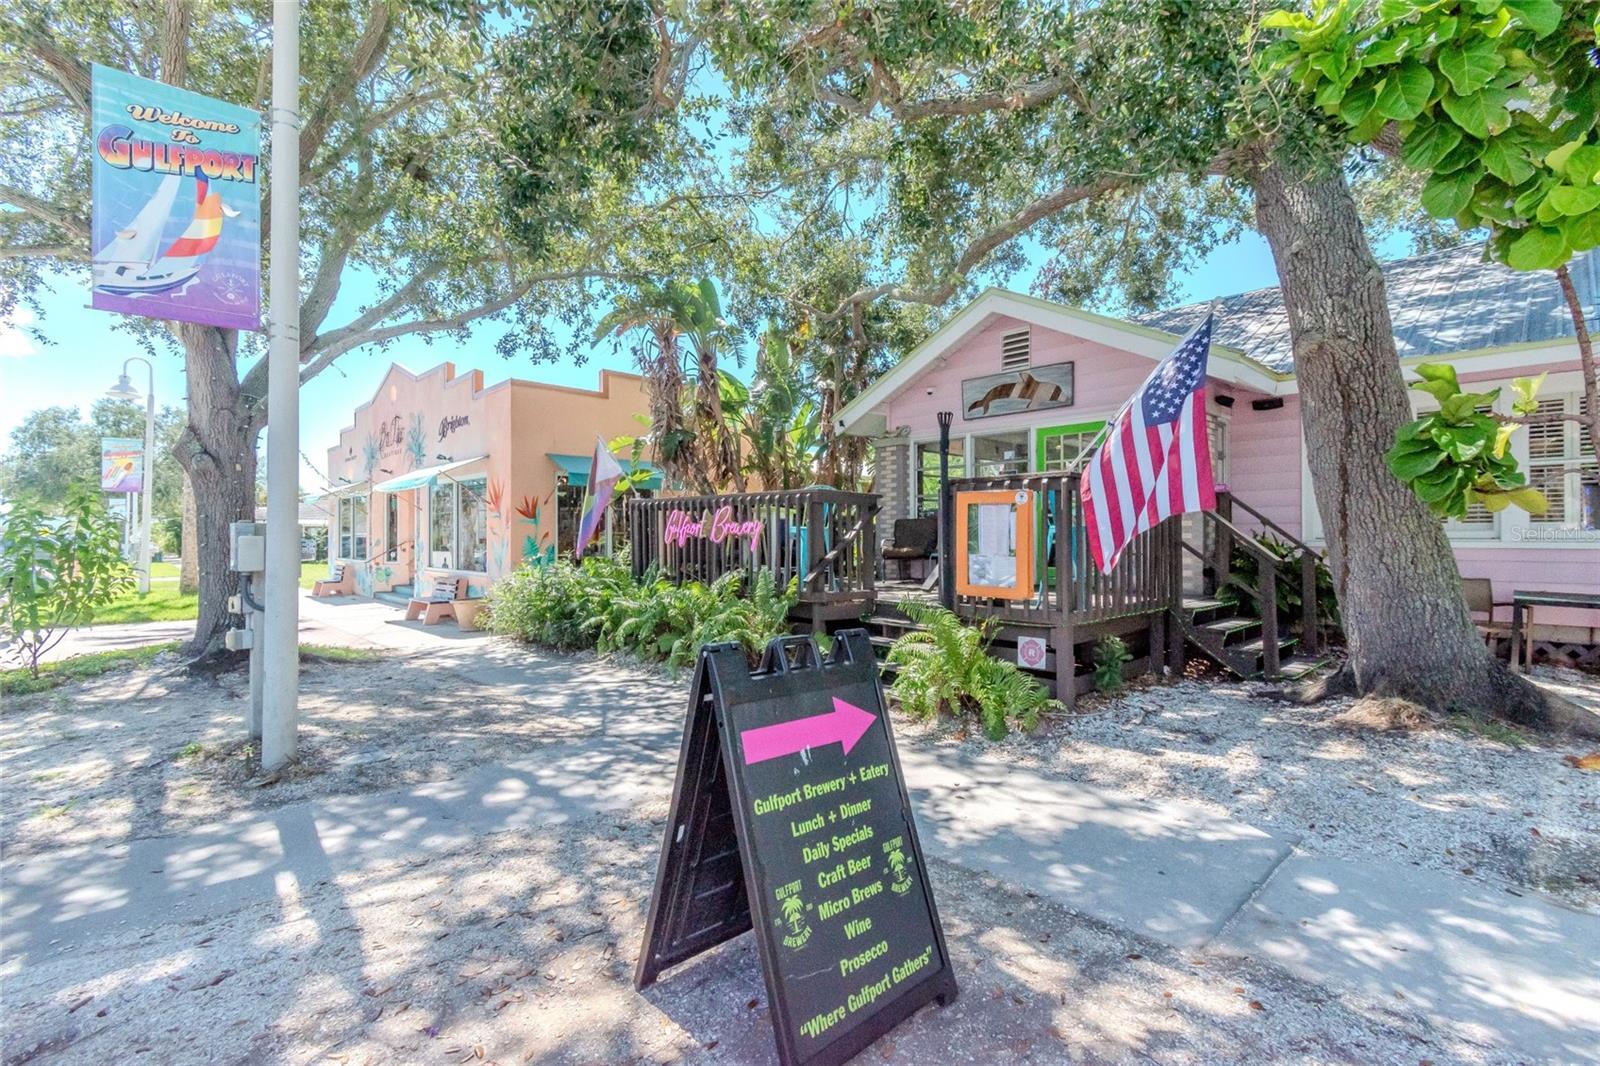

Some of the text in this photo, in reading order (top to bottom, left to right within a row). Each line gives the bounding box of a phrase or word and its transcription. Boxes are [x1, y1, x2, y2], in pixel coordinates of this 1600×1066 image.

[126, 104, 240, 134] Welcome
[170, 128, 201, 144] To
[97, 123, 259, 184] GULFPORT
[664, 505, 763, 552] Gulfport Brewery
[753, 763, 889, 816] Gulfport Brewery + Eatery
[791, 798, 872, 838] Lunch + Dinner
[802, 824, 874, 864] Daily Specials
[817, 855, 872, 888] Craft Beer
[818, 880, 884, 921] Micro Brews
[782, 924, 813, 948] BREWERY
[843, 917, 873, 940] Wine
[839, 940, 889, 977] Prosecco
[847, 974, 892, 1013] Gulfport
